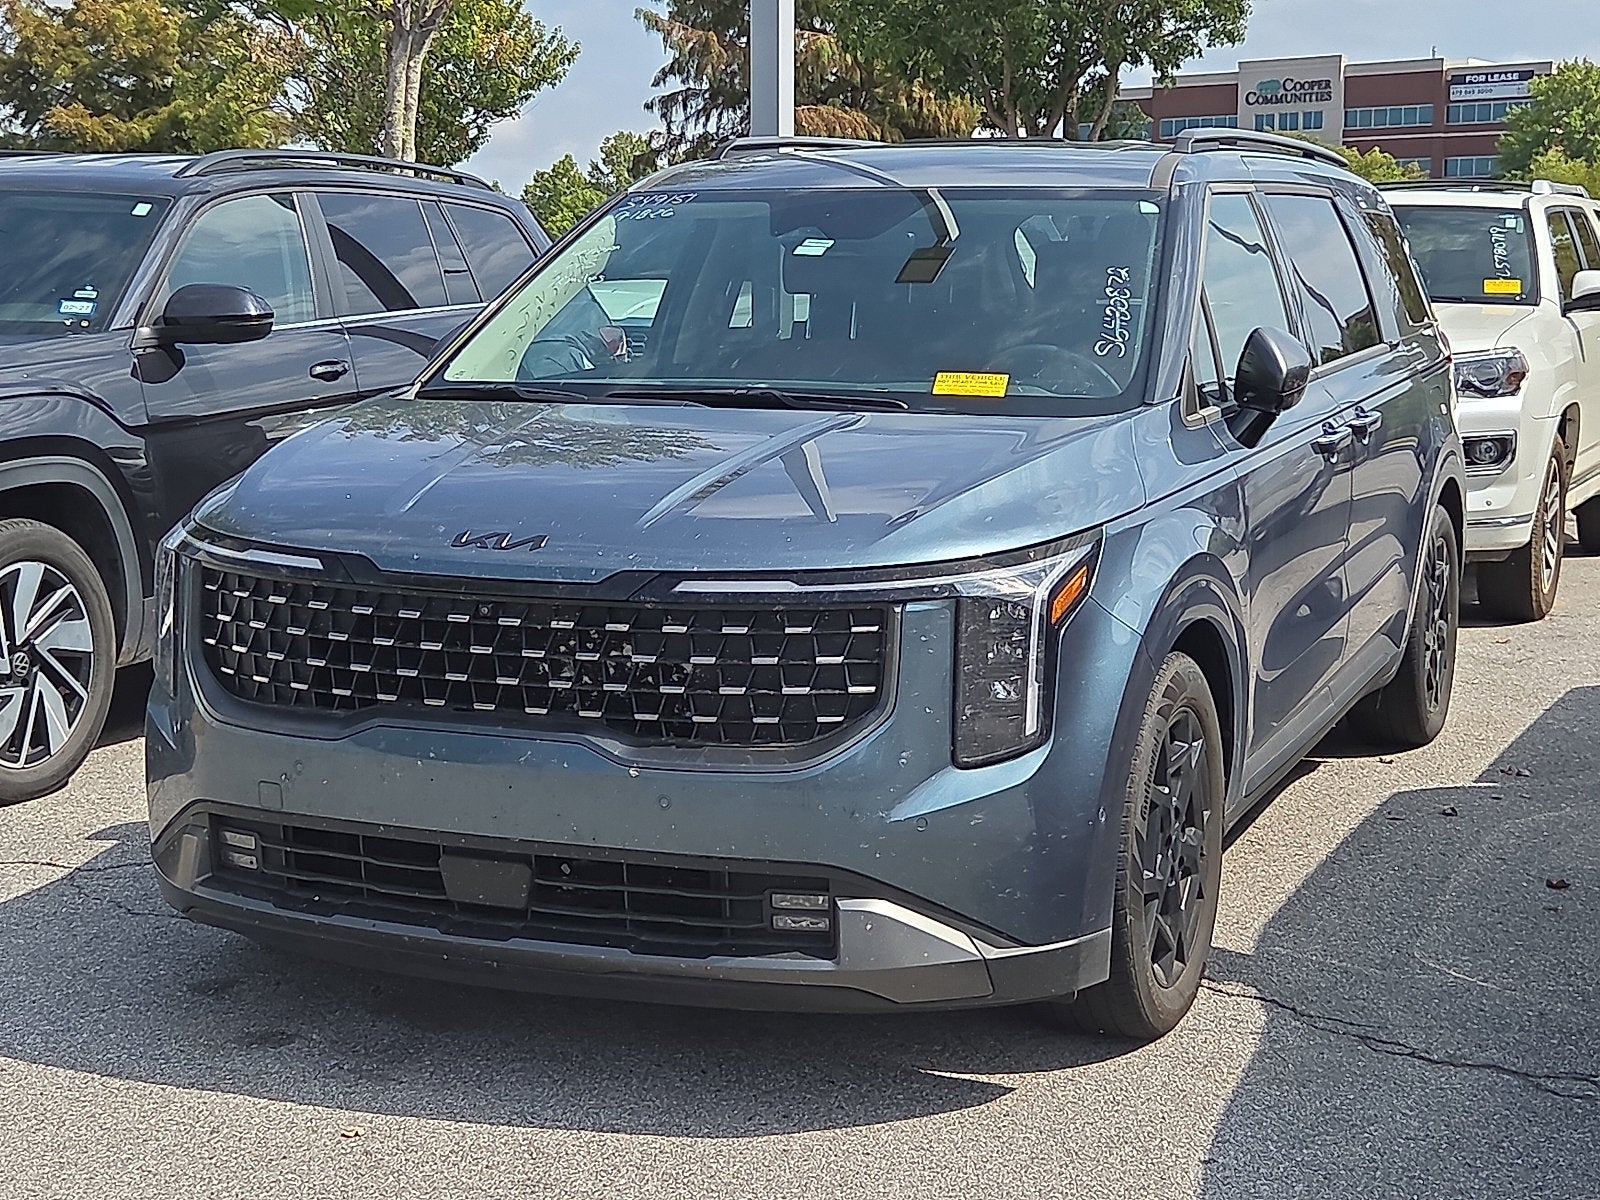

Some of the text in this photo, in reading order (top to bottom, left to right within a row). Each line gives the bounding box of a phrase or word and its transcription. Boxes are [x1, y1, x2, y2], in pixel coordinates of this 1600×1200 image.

[1465, 72, 1520, 83] FOR LEASE
[450, 530, 549, 552] KIA
